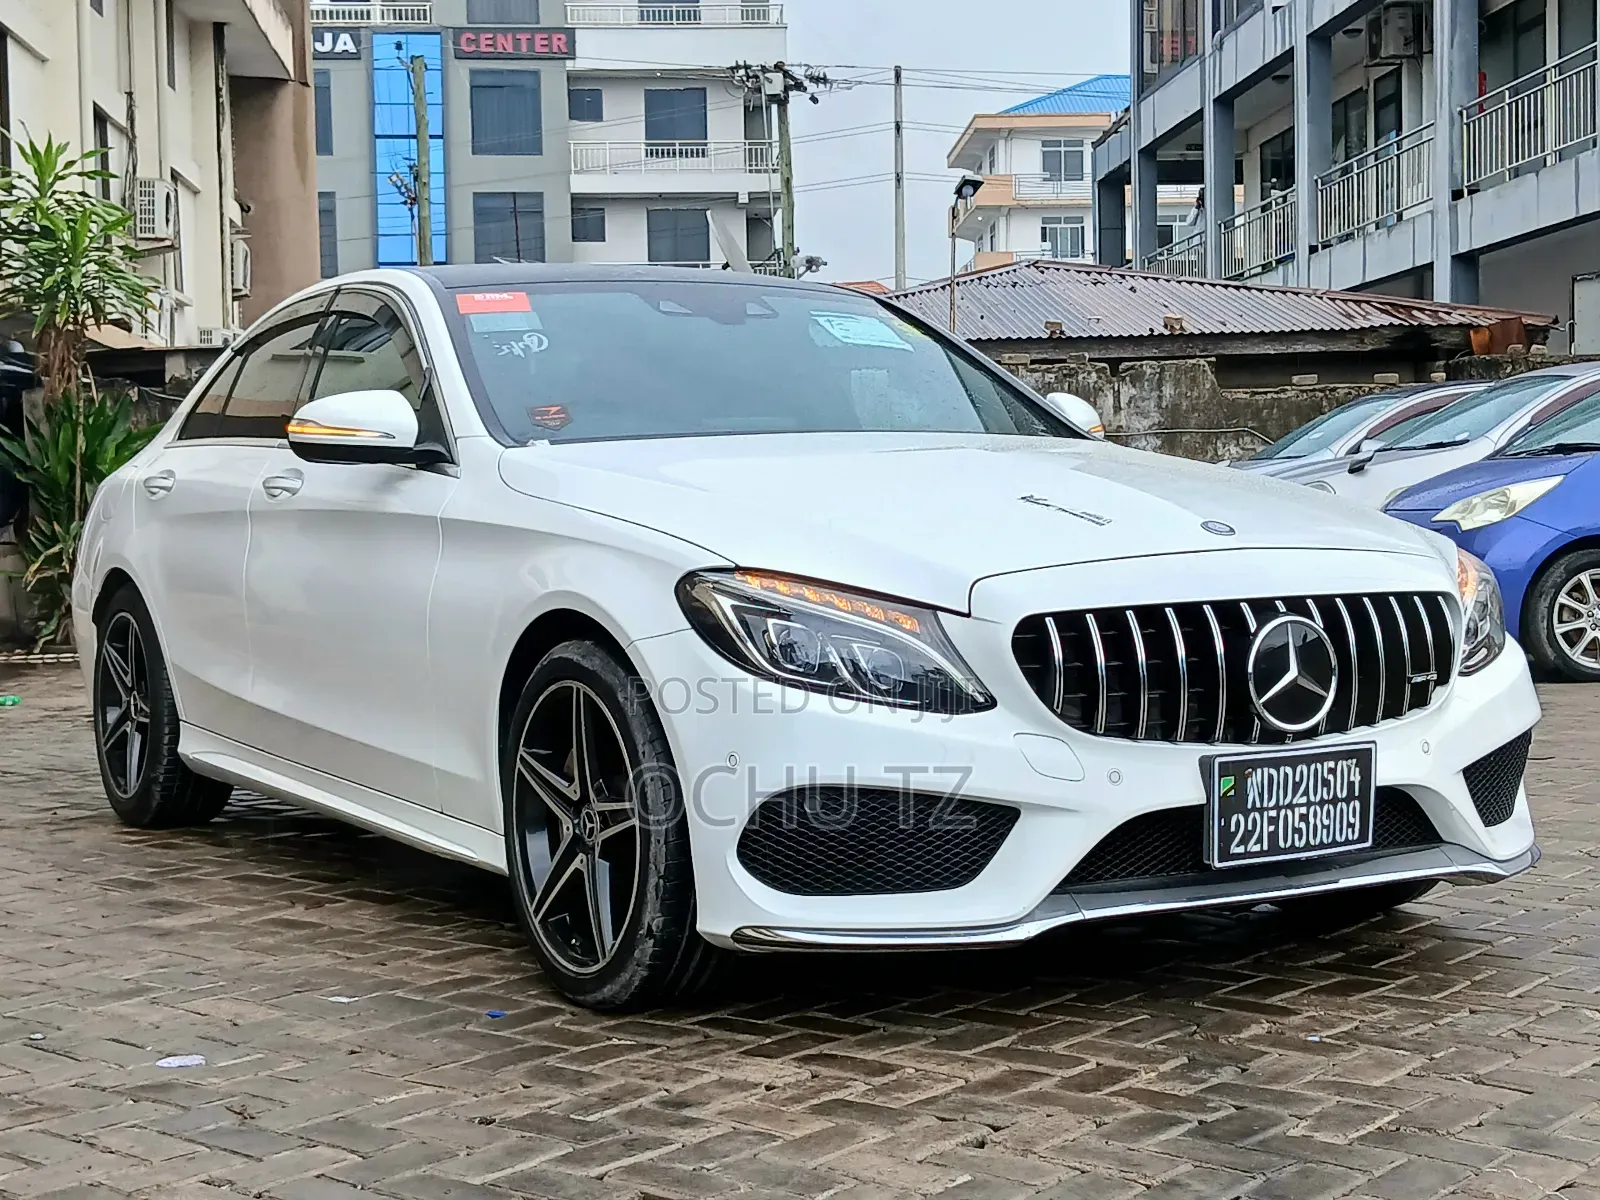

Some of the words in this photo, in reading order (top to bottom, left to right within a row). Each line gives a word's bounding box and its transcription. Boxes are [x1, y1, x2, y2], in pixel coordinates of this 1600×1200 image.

[314, 32, 357, 54] JA
[460, 32, 568, 54] CENTER
[1229, 800, 1361, 855] 22F058909
